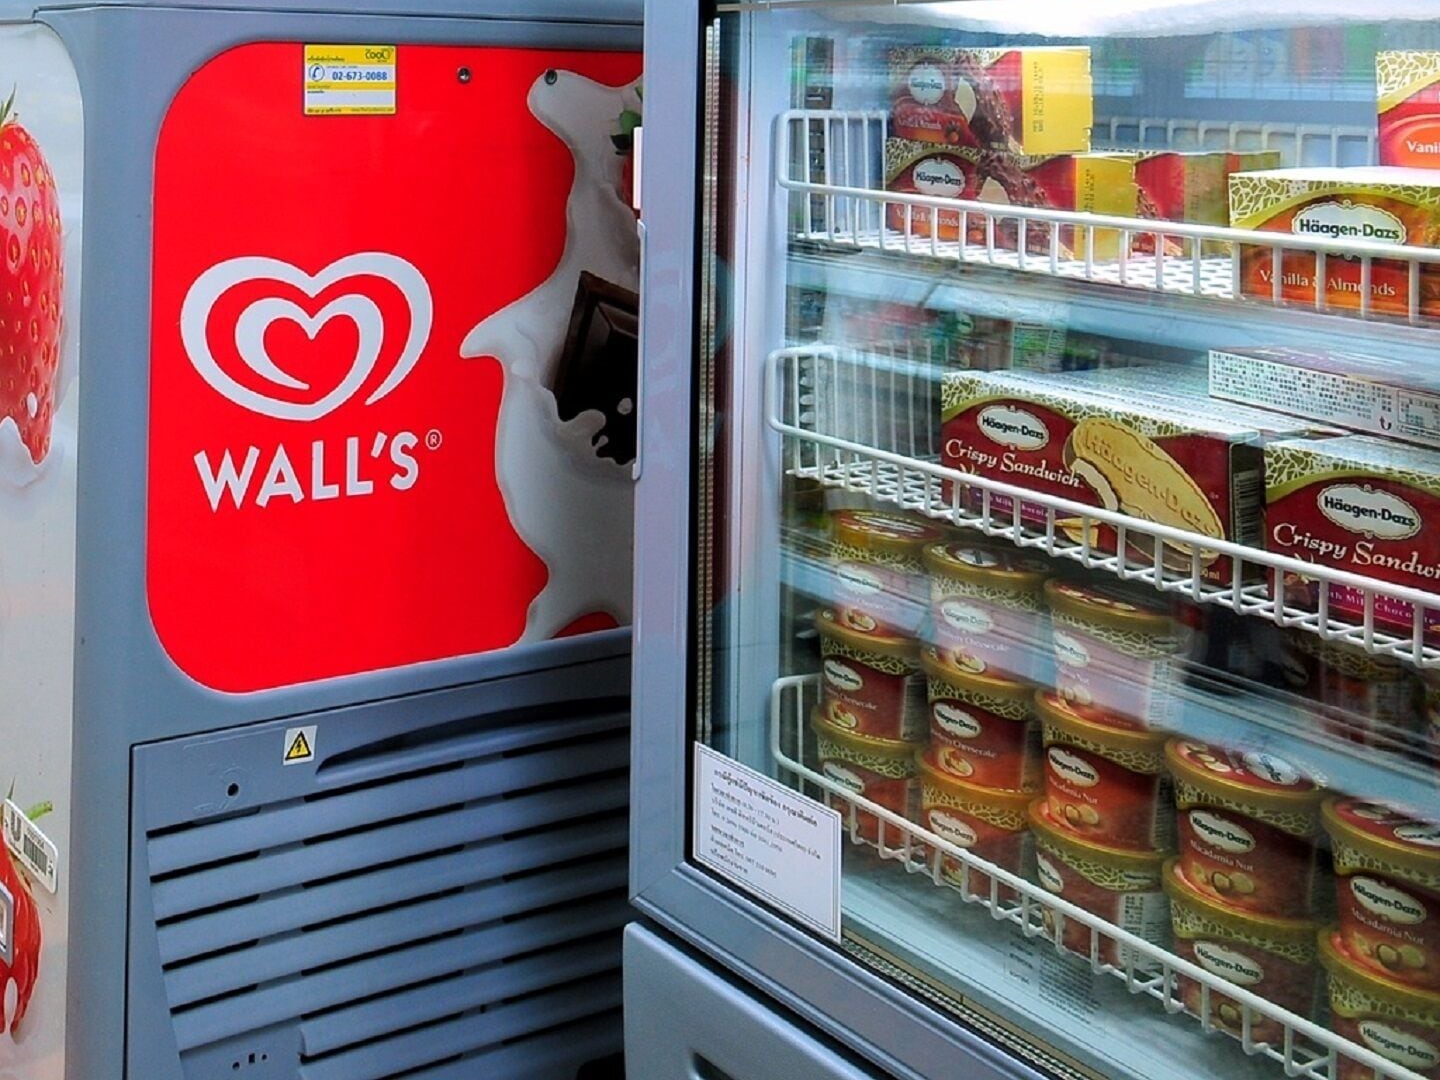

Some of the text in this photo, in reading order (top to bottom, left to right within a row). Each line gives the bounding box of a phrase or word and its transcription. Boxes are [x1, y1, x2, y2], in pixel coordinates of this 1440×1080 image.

[1299, 218, 1401, 240] Häagen-Dazs
[981, 415, 1046, 442] Häagen-Dazs
[194, 431, 419, 513] WALL'S
[945, 438, 1081, 489] Crispy Sandwich
[1324, 495, 1416, 527] Häagen-Dazs
[1273, 522, 1348, 560] Crispy
[1192, 815, 1252, 849] Häagen-Dazs
[1235, 858, 1254, 873] Nut
[1353, 881, 1423, 919] Häagen-Dazs
